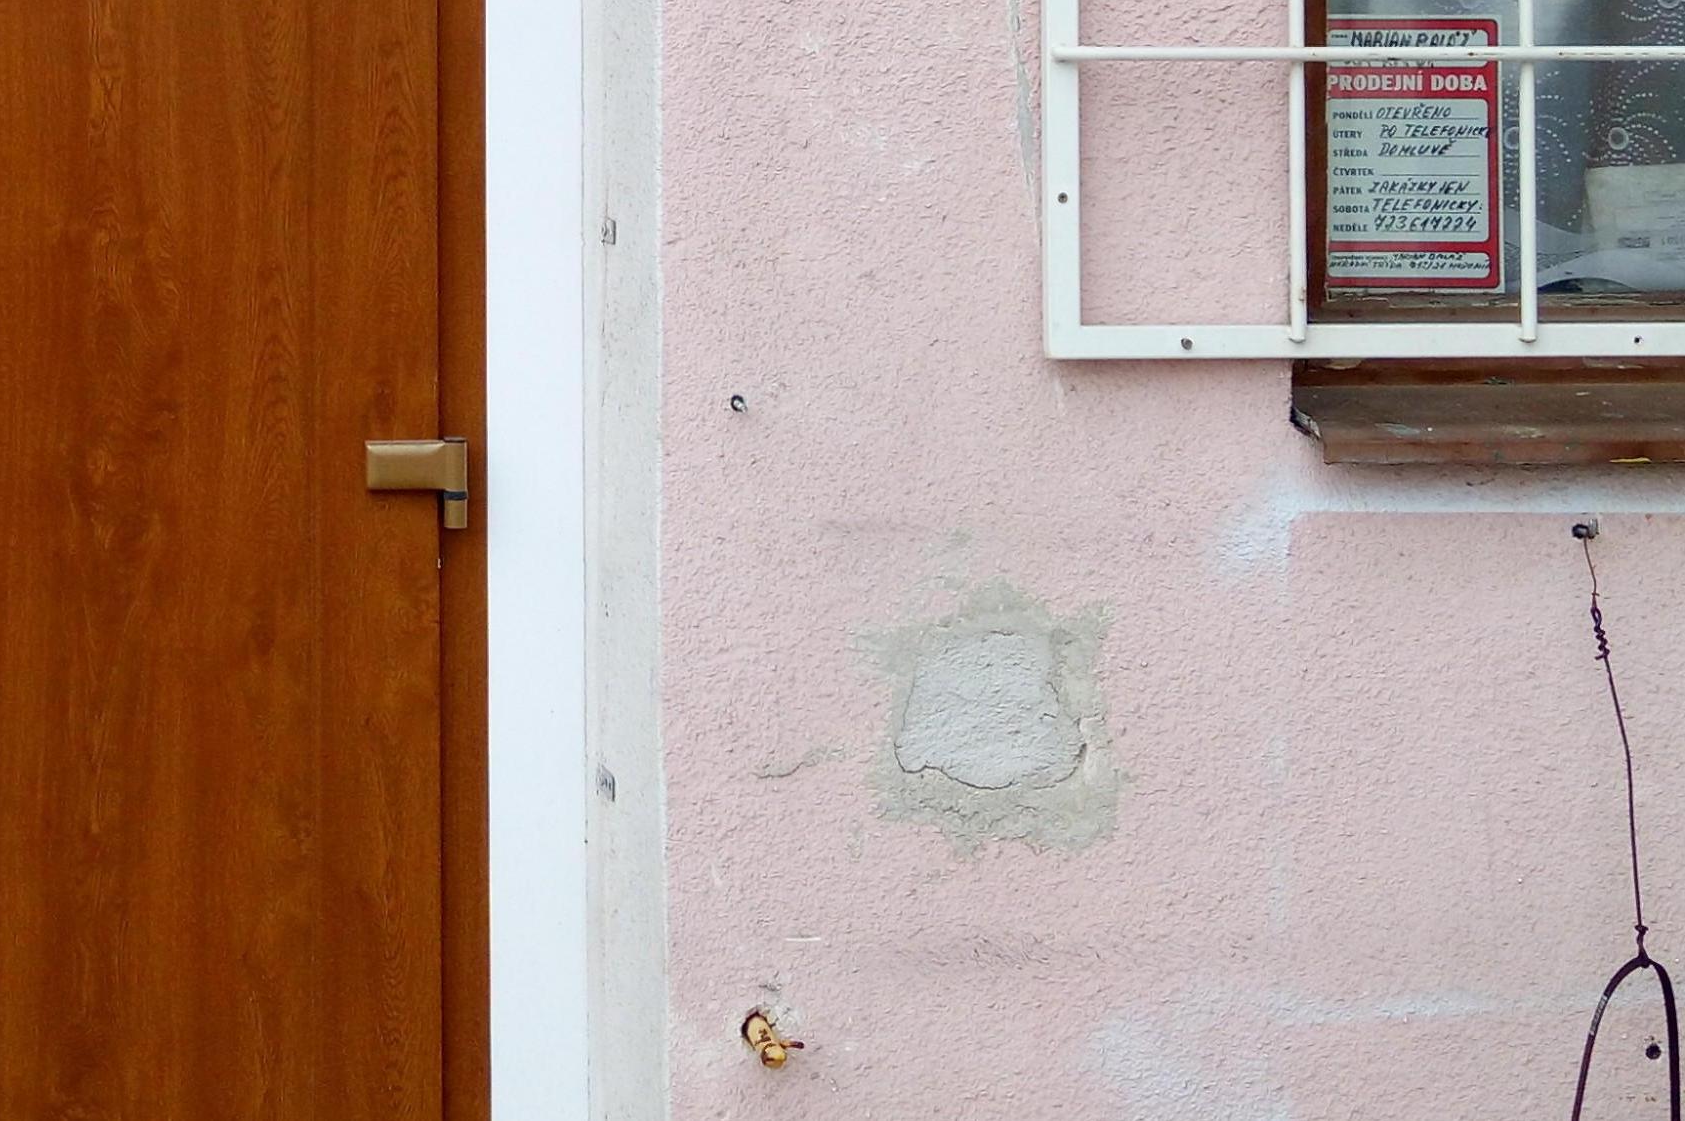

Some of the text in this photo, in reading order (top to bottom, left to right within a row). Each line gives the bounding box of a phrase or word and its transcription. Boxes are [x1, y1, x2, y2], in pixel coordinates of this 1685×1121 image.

[1328, 70, 1488, 92] PRODEJNÍ DOBA
[1376, 103, 1451, 119] OTEVŘENO
[1379, 124, 1397, 138] PO
[1332, 147, 1368, 158] STŘEDA
[1332, 166, 1375, 176] ČTVRTEK
[1332, 185, 1363, 195] PÁTEK
[1332, 205, 1370, 214] SOBOTA
[1332, 222, 1369, 232] NEDĚLE
